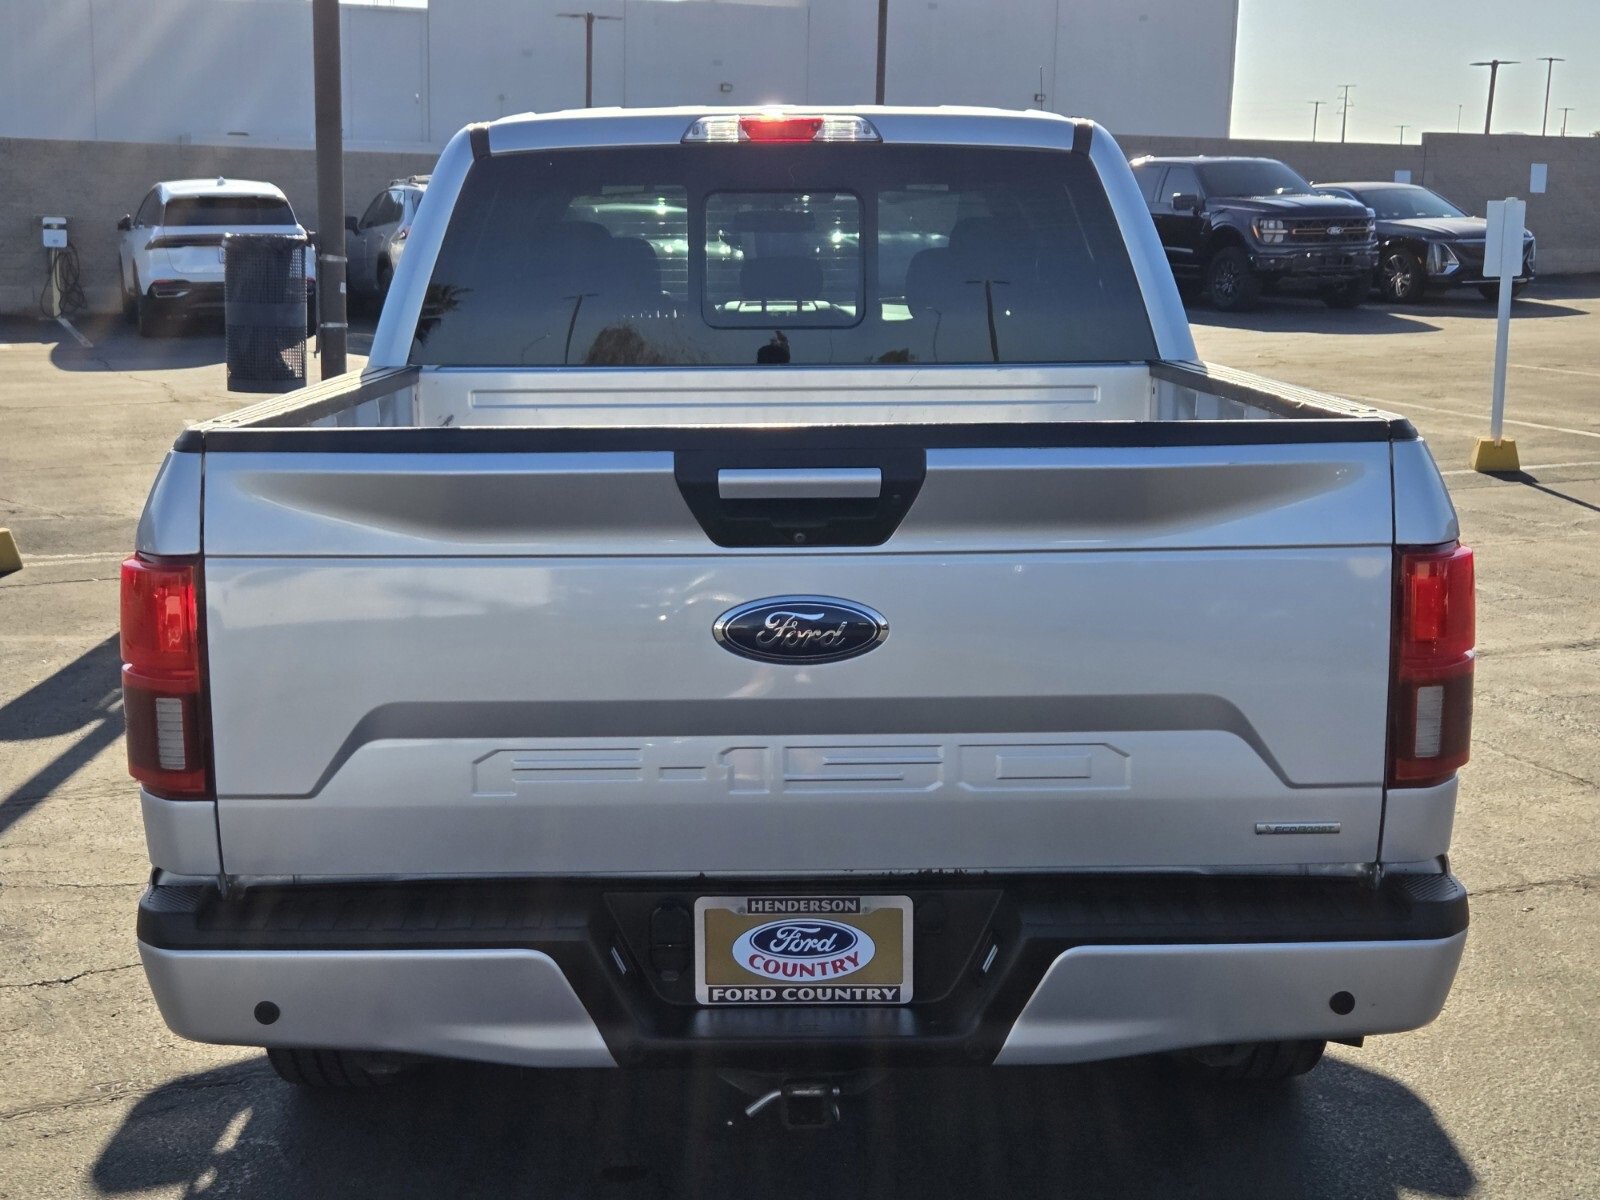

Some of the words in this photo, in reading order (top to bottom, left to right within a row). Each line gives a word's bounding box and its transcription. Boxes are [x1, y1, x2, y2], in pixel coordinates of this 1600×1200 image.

[756, 611, 848, 648] Ford
[472, 742, 1132, 797] F-150
[751, 899, 857, 912] HENDERSON
[769, 926, 838, 953] Ford
[748, 951, 860, 978] COUNTRY
[712, 988, 777, 1001] FORD
[781, 987, 897, 1001] COUNTRY
